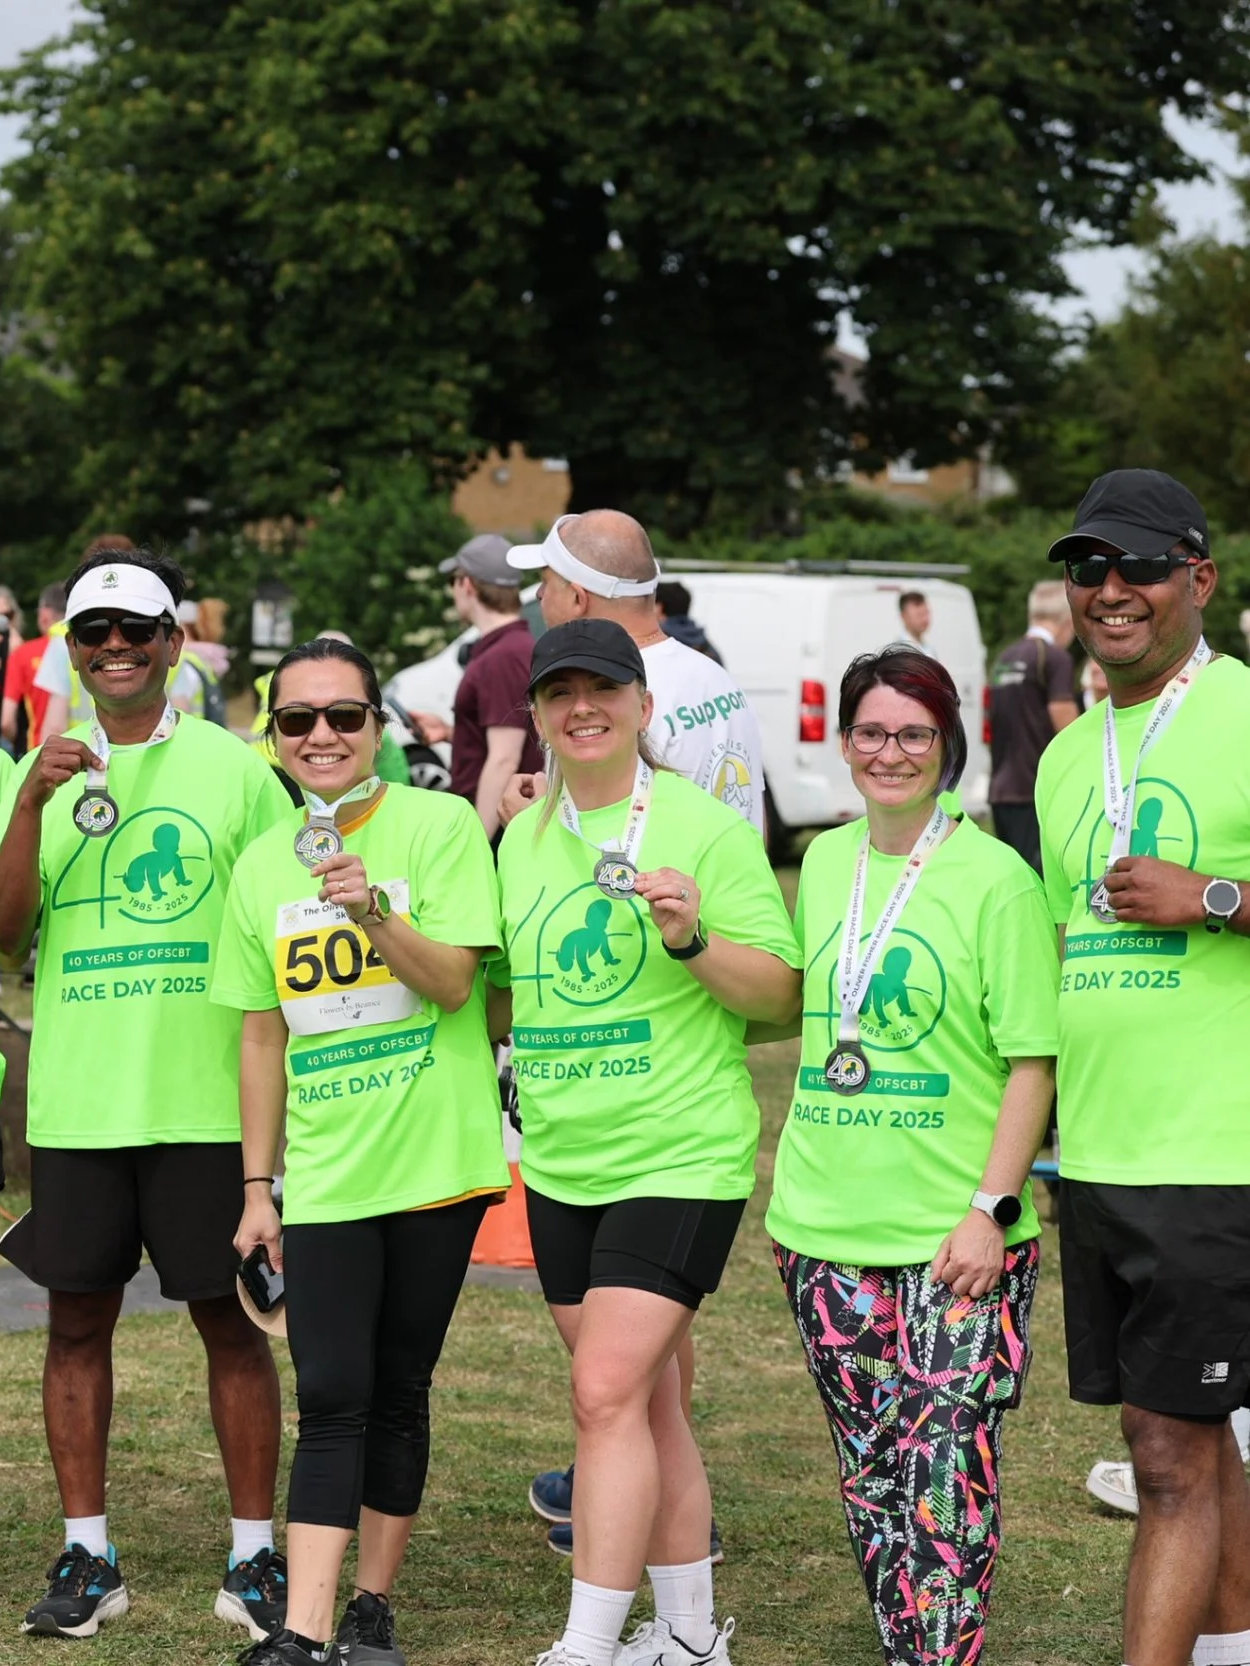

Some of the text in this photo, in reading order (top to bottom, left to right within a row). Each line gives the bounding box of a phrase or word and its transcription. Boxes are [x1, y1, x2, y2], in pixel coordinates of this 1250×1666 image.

[676, 688, 748, 730] Suppor
[128, 893, 189, 912] 1985 2025
[303, 907, 319, 916] The
[335, 911, 347, 920] 5k
[851, 882, 907, 997] OLIVER FISHER RACE DAY 2025
[1067, 937, 1164, 952] YEARS OF OFSCBT
[69, 947, 191, 967] 40 YEARS OF OFSCBT
[61, 977, 206, 1004] RACE DAY 2025
[560, 973, 619, 993] 1985 2025
[1074, 971, 1114, 991] DAY
[1119, 970, 1181, 989] 2025
[320, 1005, 344, 1015] Flowers
[519, 1028, 629, 1044] 40 YEARS OF OFSCBT
[891, 1024, 913, 1041] 2025
[307, 1031, 429, 1067] 40 YEARS OF OFSCBT
[513, 1056, 650, 1079] RACE DAY 2025
[298, 1081, 343, 1104] RACE
[348, 1070, 393, 1095] DAY
[875, 1078, 927, 1091] OFSCBT
[794, 1103, 944, 1129] RACE DAY 2025
